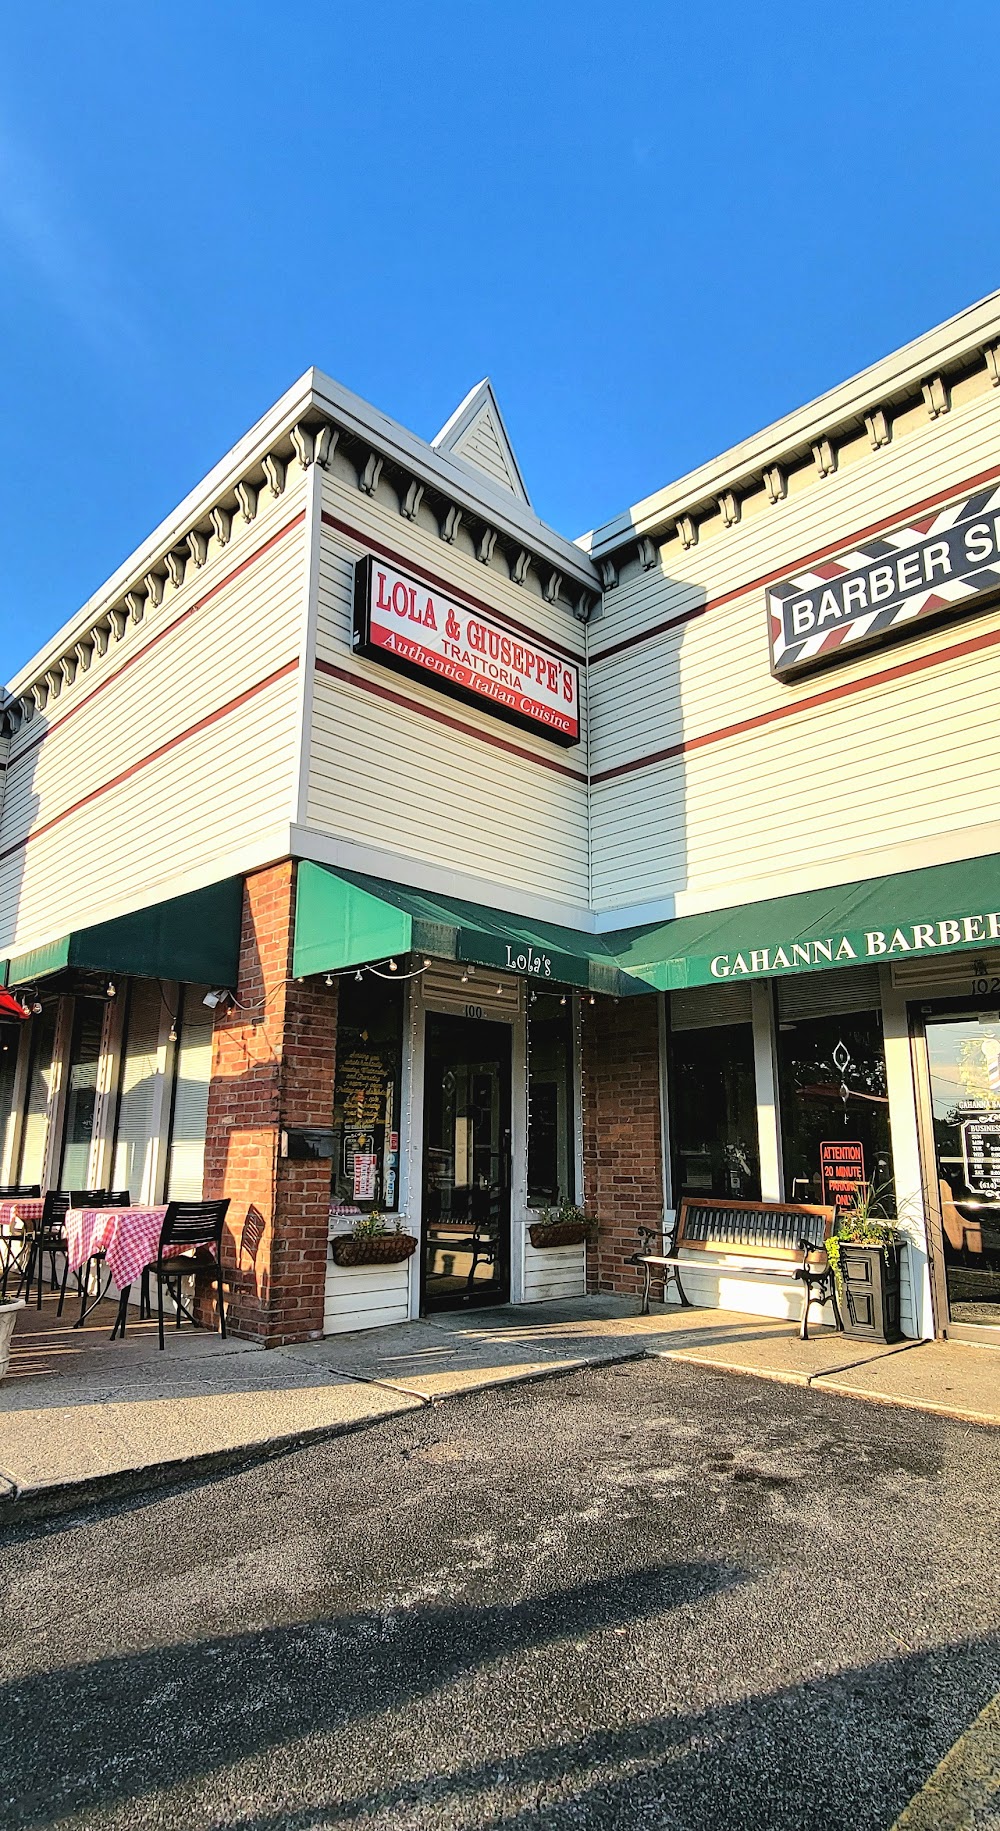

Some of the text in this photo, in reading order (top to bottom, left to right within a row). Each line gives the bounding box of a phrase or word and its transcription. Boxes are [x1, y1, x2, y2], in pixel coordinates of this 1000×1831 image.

[792, 517, 1000, 635] BARBER S
[376, 572, 573, 703] LOLA & GIUSEPPE'S
[381, 632, 571, 731] Authentic Italian Cuisine
[441, 639, 523, 691] TRATTORIA
[505, 945, 552, 976] Lola's
[710, 936, 858, 978] GAHANNA
[465, 1004, 482, 1018] 100
[823, 1146, 861, 1160] ATTENTION
[824, 1165, 861, 1178] 20 MINUTE
